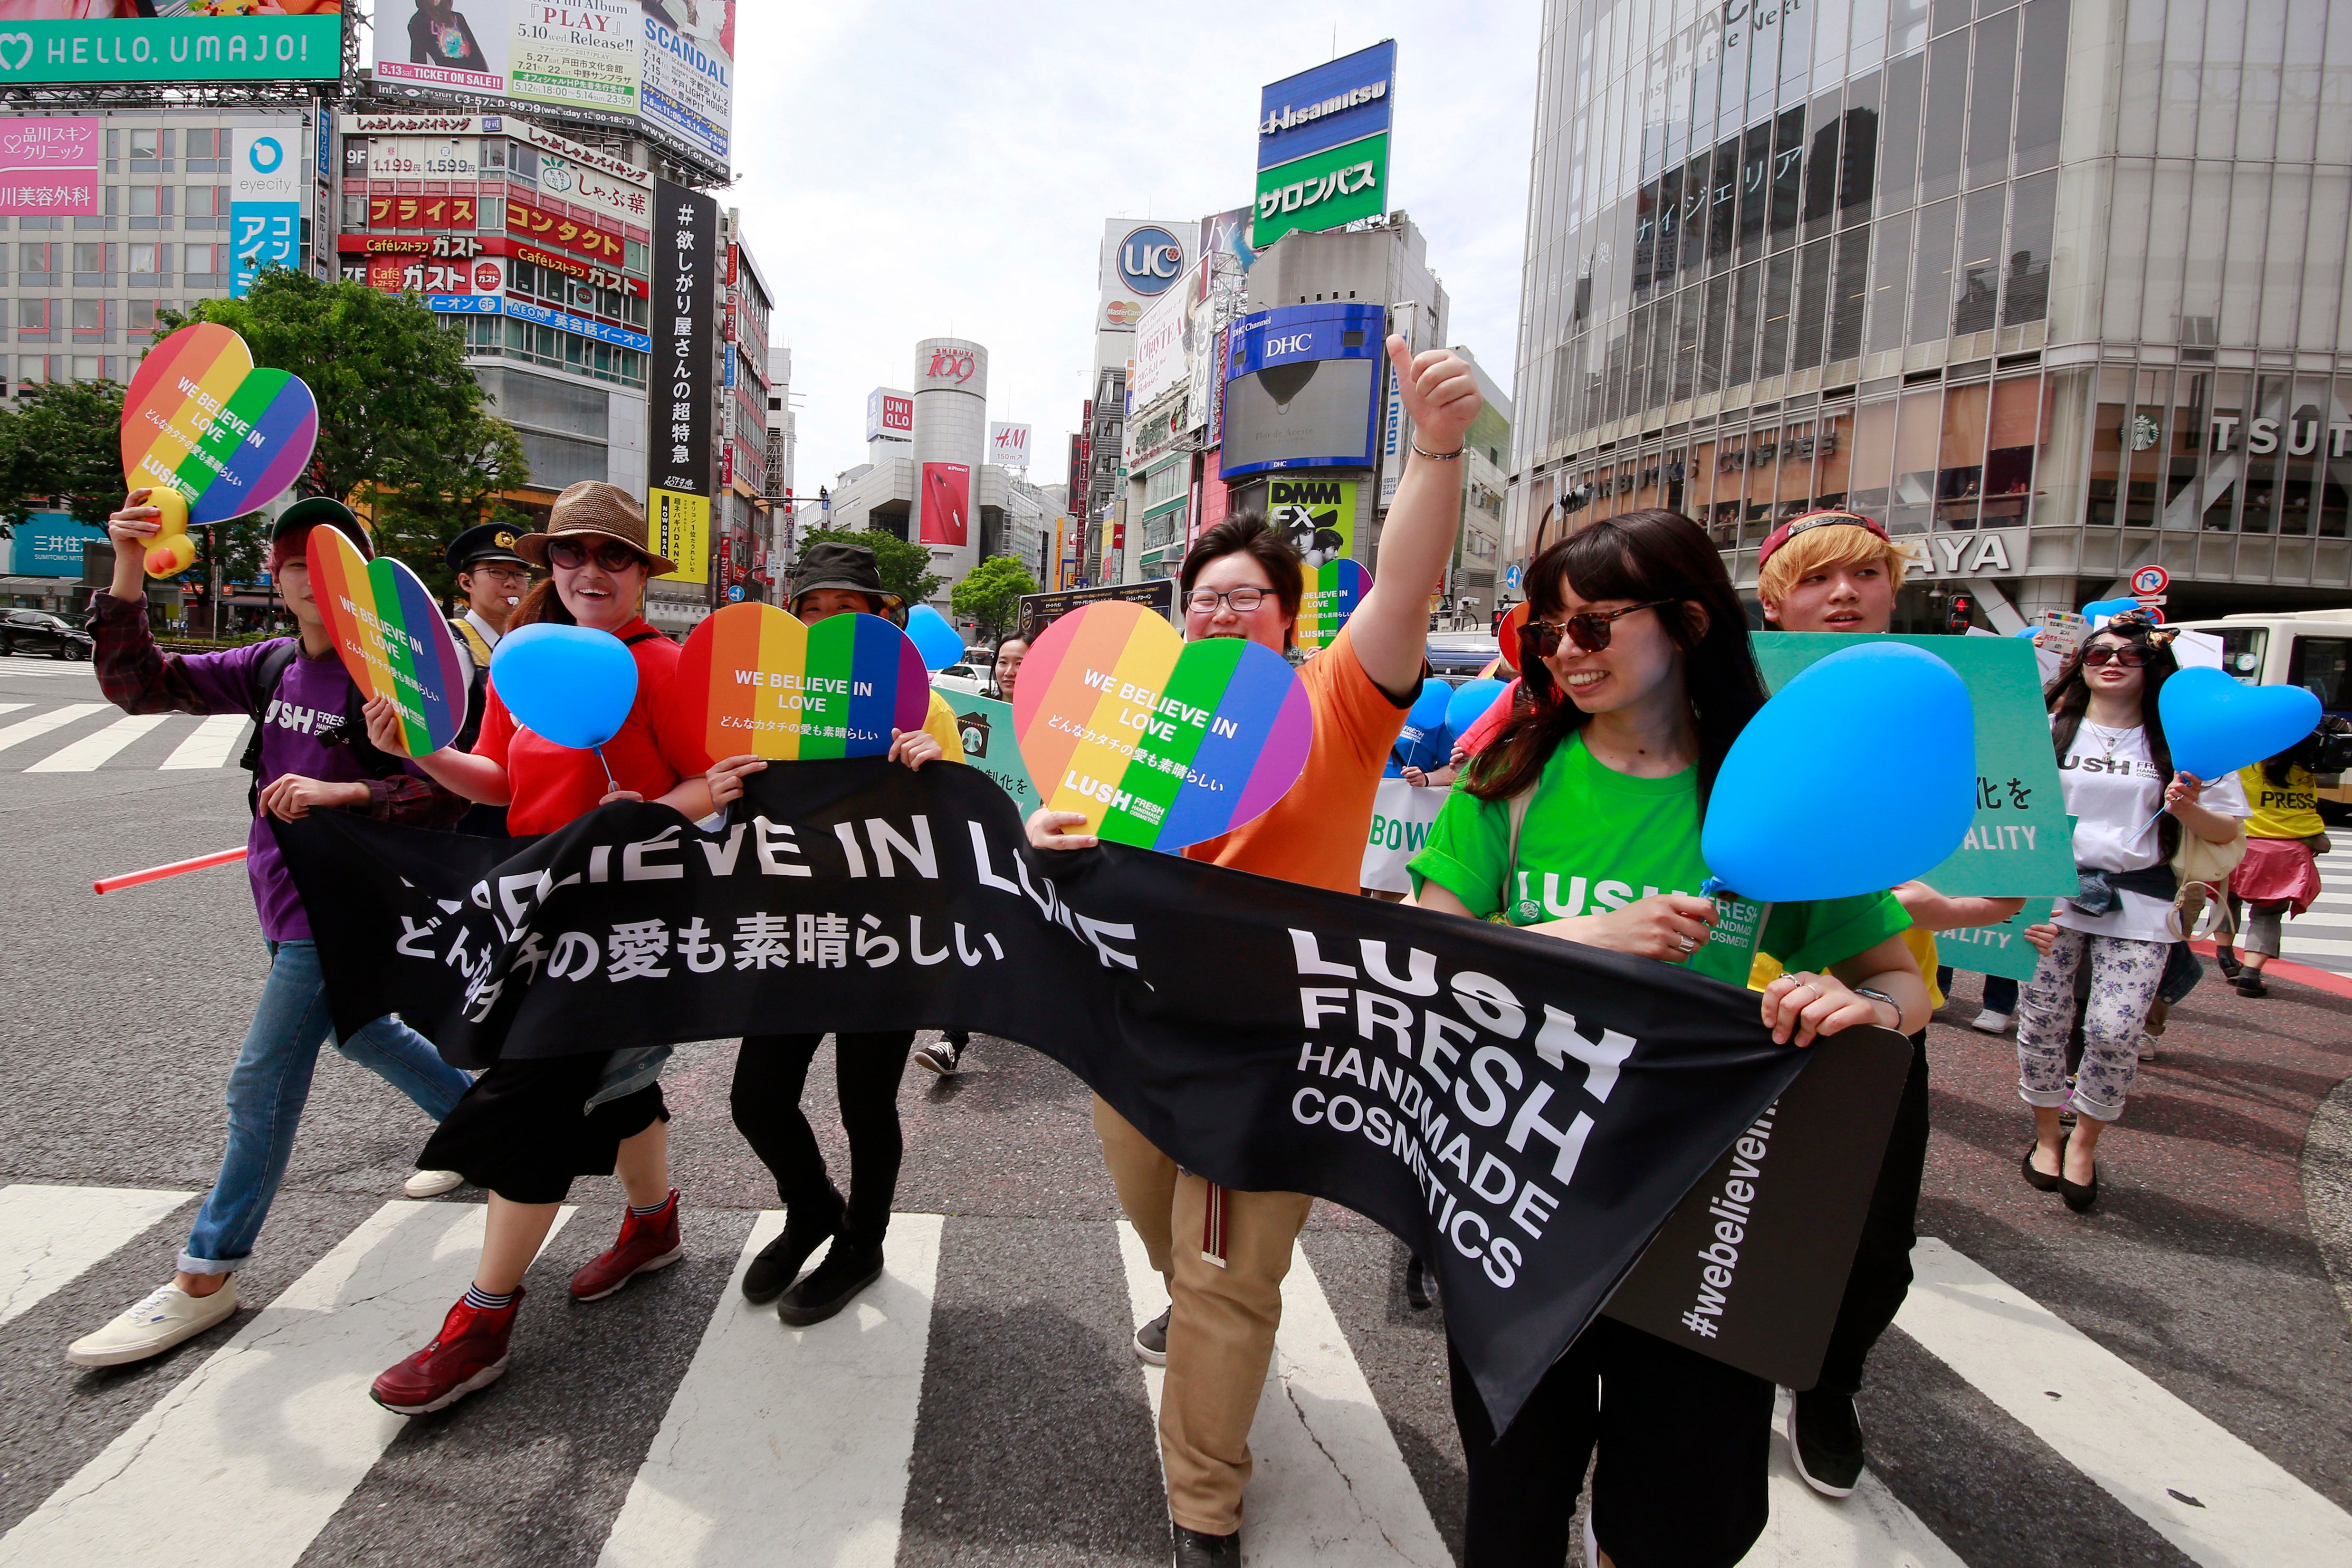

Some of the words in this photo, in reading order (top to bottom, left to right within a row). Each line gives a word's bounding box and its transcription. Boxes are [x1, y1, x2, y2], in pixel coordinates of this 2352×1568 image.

[585, 0, 627, 14] Album
[48, 37, 158, 64] HELLO,
[170, 35, 307, 62] UMAJO!
[571, 31, 633, 52] Release!!
[645, 18, 728, 88] SCANDAL
[562, 57, 623, 74] 戸田市文化会館
[413, 67, 449, 81] TICKET
[451, 72, 464, 83] ON
[467, 76, 500, 88] SALE!!
[574, 69, 631, 85] 中野サンプラザ
[707, 99, 728, 117] HOUSE
[713, 91, 728, 107] VJ-2
[1258, 80, 1386, 134] Hisamitsu
[23, 127, 92, 143] 品川スキン
[357, 117, 471, 131] しゃぶしゃぶバイキング
[484, 120, 499, 129] 寿司
[23, 145, 85, 160] クリニック
[346, 150, 366, 164] 9F
[441, 147, 450, 156] 夜
[529, 127, 647, 182] しゃぶしゃぶバイキング
[0, 186, 91, 207] 川美容外科
[240, 179, 291, 194] eyecity
[579, 173, 645, 214] しゃぶ葉
[1258, 160, 1376, 219] サロンパス
[371, 201, 473, 221] プライス
[507, 204, 620, 256] コンタクト
[366, 239, 429, 253] Caféレストラン
[432, 235, 483, 258] ガスト
[343, 268, 366, 283] 7F
[373, 267, 400, 279] Café
[402, 264, 466, 292] ガスト
[478, 275, 499, 284] ガスト
[518, 248, 584, 277] Caféレストラン
[588, 267, 638, 296] ガスト
[373, 280, 399, 288] レストラン
[425, 296, 474, 310] イーオン
[480, 299, 494, 309] 6F
[511, 303, 546, 321] AEON
[1107, 308, 1141, 317] MasterCard
[671, 203, 695, 464] #欲しがり屋さんの超特急
[1233, 326, 1245, 338] DHC
[1245, 316, 1272, 332] Channel
[936, 348, 974, 357] SHIBUYA
[1266, 333, 1312, 358] DHC
[926, 354, 975, 384] 109
[178, 376, 200, 399] WE
[197, 392, 250, 437] BELIEVE
[247, 430, 266, 449] IN
[887, 400, 908, 414] UNI
[191, 412, 226, 443] LOVE
[886, 413, 909, 427] QLO
[1386, 402, 1400, 456] neon
[145, 409, 242, 487] どんなカタチの愛も素晴らしい
[994, 427, 1027, 450] H&M
[142, 454, 182, 488] LUSH
[1271, 483, 1341, 505] DMM
[1270, 506, 1316, 528] FX
[662, 525, 668, 537] ON
[1892, 535, 2010, 572] AYA
[1304, 590, 1337, 599] BELIEVE
[1308, 600, 1329, 608] LOVE
[339, 594, 359, 618] WE
[358, 606, 409, 647] BELIEVE
[408, 635, 424, 656] IN
[1300, 630, 1325, 638] LUSH
[370, 631, 401, 660] LOVE
[345, 638, 440, 702] どんなカタチの愛も素晴らしい
[735, 669, 764, 686] WE
[770, 673, 848, 695] BELIEVE
[853, 681, 873, 697] IN
[778, 694, 827, 712] LOVE
[1083, 669, 1117, 694] WE
[1119, 682, 1209, 728] BELIEVE
[1211, 716, 1238, 739] IN
[317, 711, 348, 727] FRES
[720, 716, 879, 741] どんなカタチの愛も素晴らしい
[1119, 708, 1177, 742] LOVE
[1048, 714, 1224, 792] どんなカタチの愛も素晴らしい
[1064, 770, 1133, 812] LUSH
[1133, 797, 1165, 816] FRESH
[2260, 791, 2317, 809] PRESS
[1129, 809, 1160, 826] COSMETICS
[1131, 804, 1162, 821] HANDMADE
[1369, 814, 1433, 852] BOW
[834, 814, 939, 879] IN
[1711, 929, 1749, 949] OSMETICS
[1288, 927, 1637, 1104] LUSH
[1299, 986, 1595, 1186] FRESH
[1297, 1042, 1559, 1240] HANDMADE
[1291, 1088, 1523, 1289] COSMETICS
